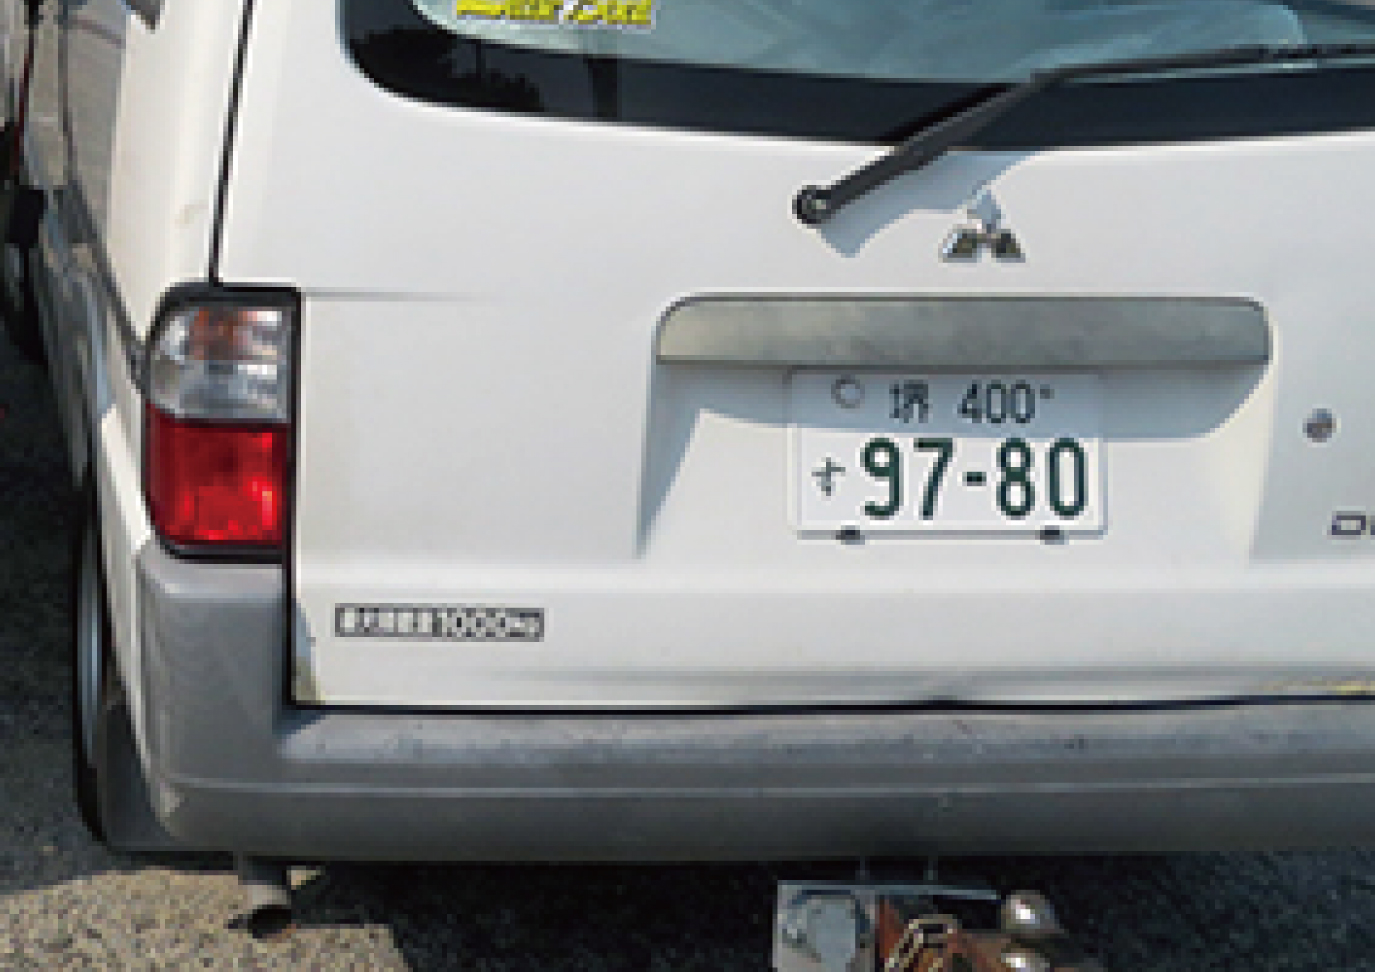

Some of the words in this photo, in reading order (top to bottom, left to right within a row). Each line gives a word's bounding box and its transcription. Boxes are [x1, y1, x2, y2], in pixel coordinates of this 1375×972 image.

[890, 382, 931, 425] 堺
[959, 381, 1036, 425] 400
[862, 437, 1086, 519] 97-80
[1330, 510, 1375, 538] D
